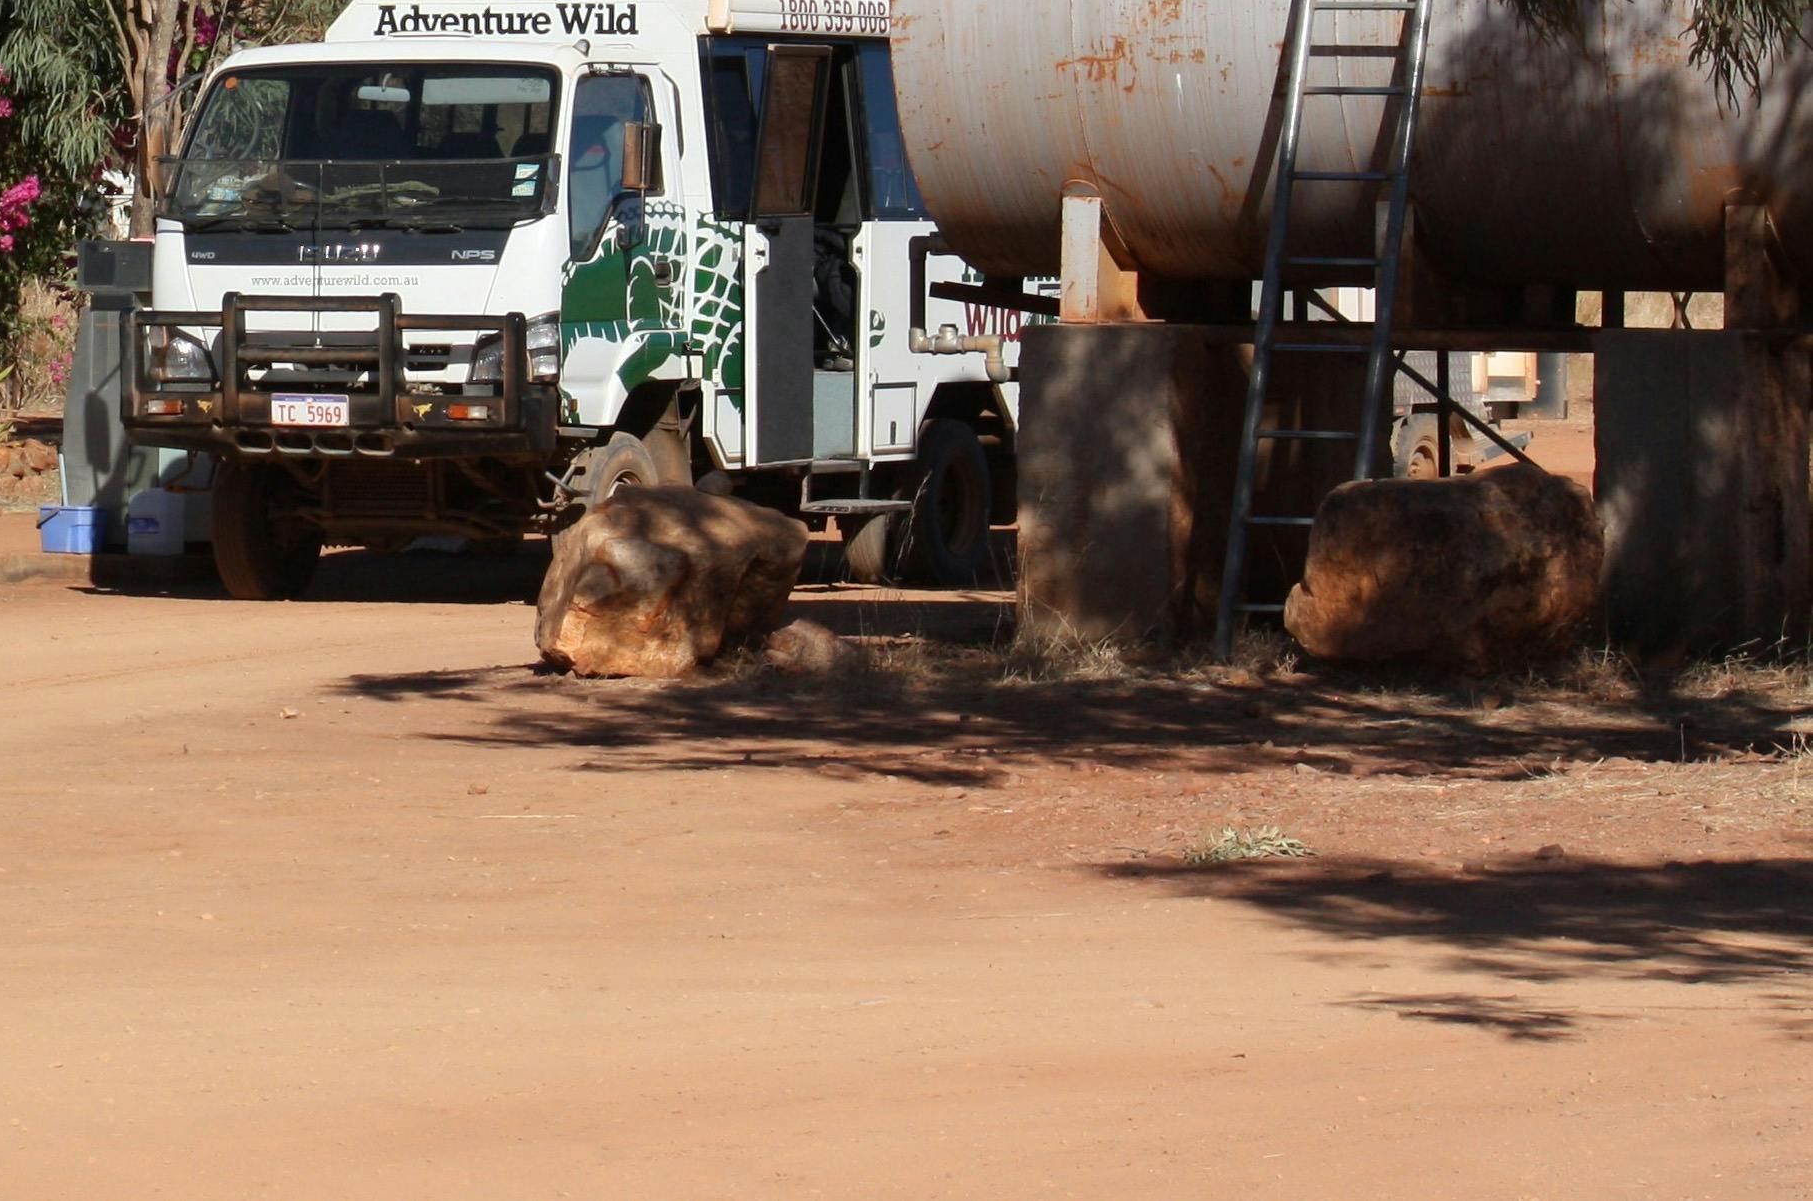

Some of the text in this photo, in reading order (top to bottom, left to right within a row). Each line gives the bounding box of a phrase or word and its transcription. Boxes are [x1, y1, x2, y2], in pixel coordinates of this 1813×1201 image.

[374, 3, 639, 36] Adventure Wild
[824, 0, 853, 33] 359
[858, 1, 888, 34] 008
[451, 249, 495, 261] NPS
[279, 405, 342, 423] TC 5969
